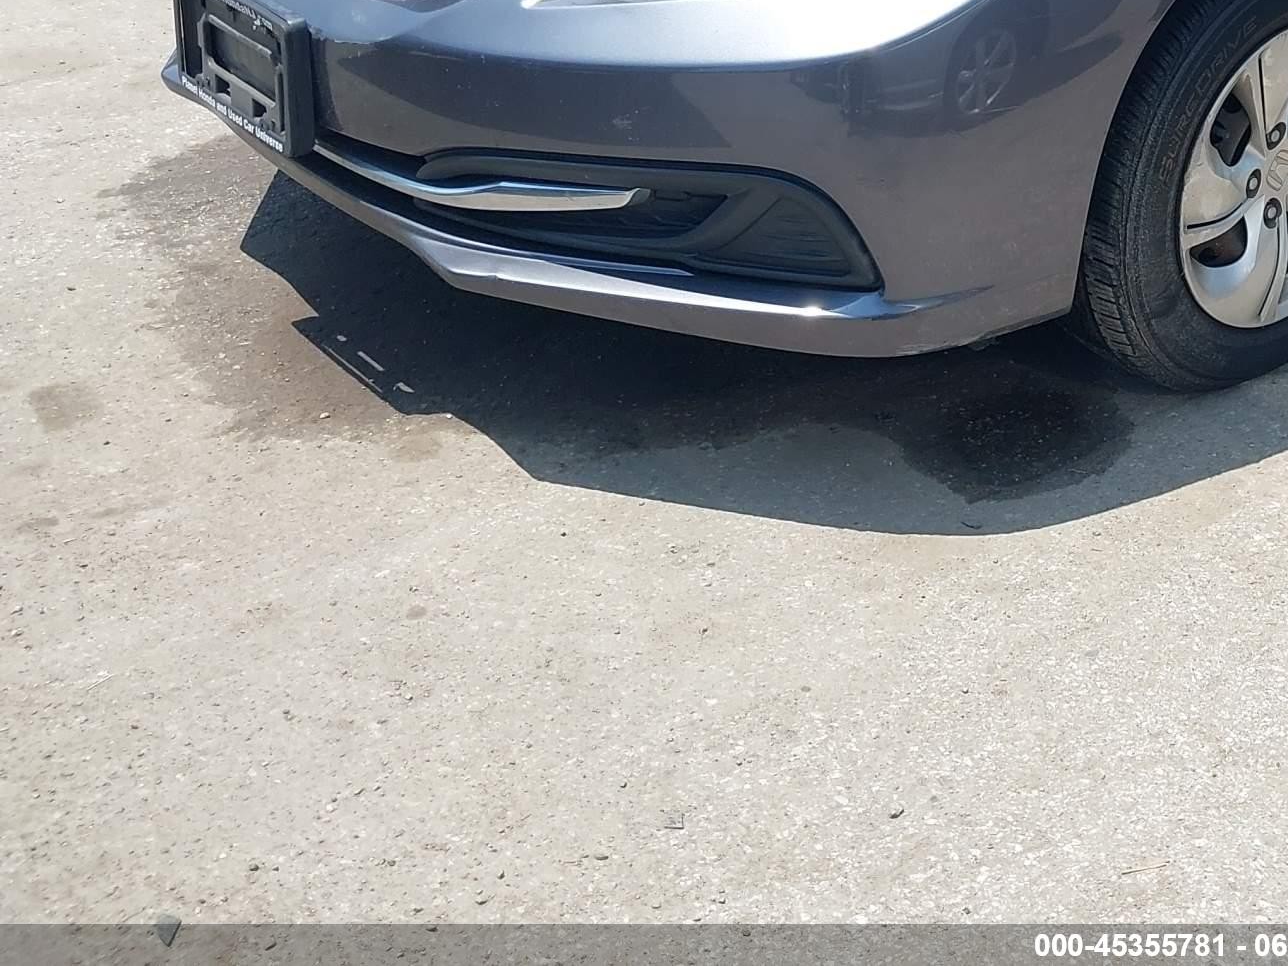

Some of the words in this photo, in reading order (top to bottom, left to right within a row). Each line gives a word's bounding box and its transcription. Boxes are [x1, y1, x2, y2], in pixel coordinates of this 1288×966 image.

[181, 74, 199, 96] Planet
[198, 89, 216, 108] Honda
[216, 102, 227, 116] and
[227, 107, 243, 127] Used
[243, 118, 255, 134] Car
[255, 126, 283, 153] Universe
